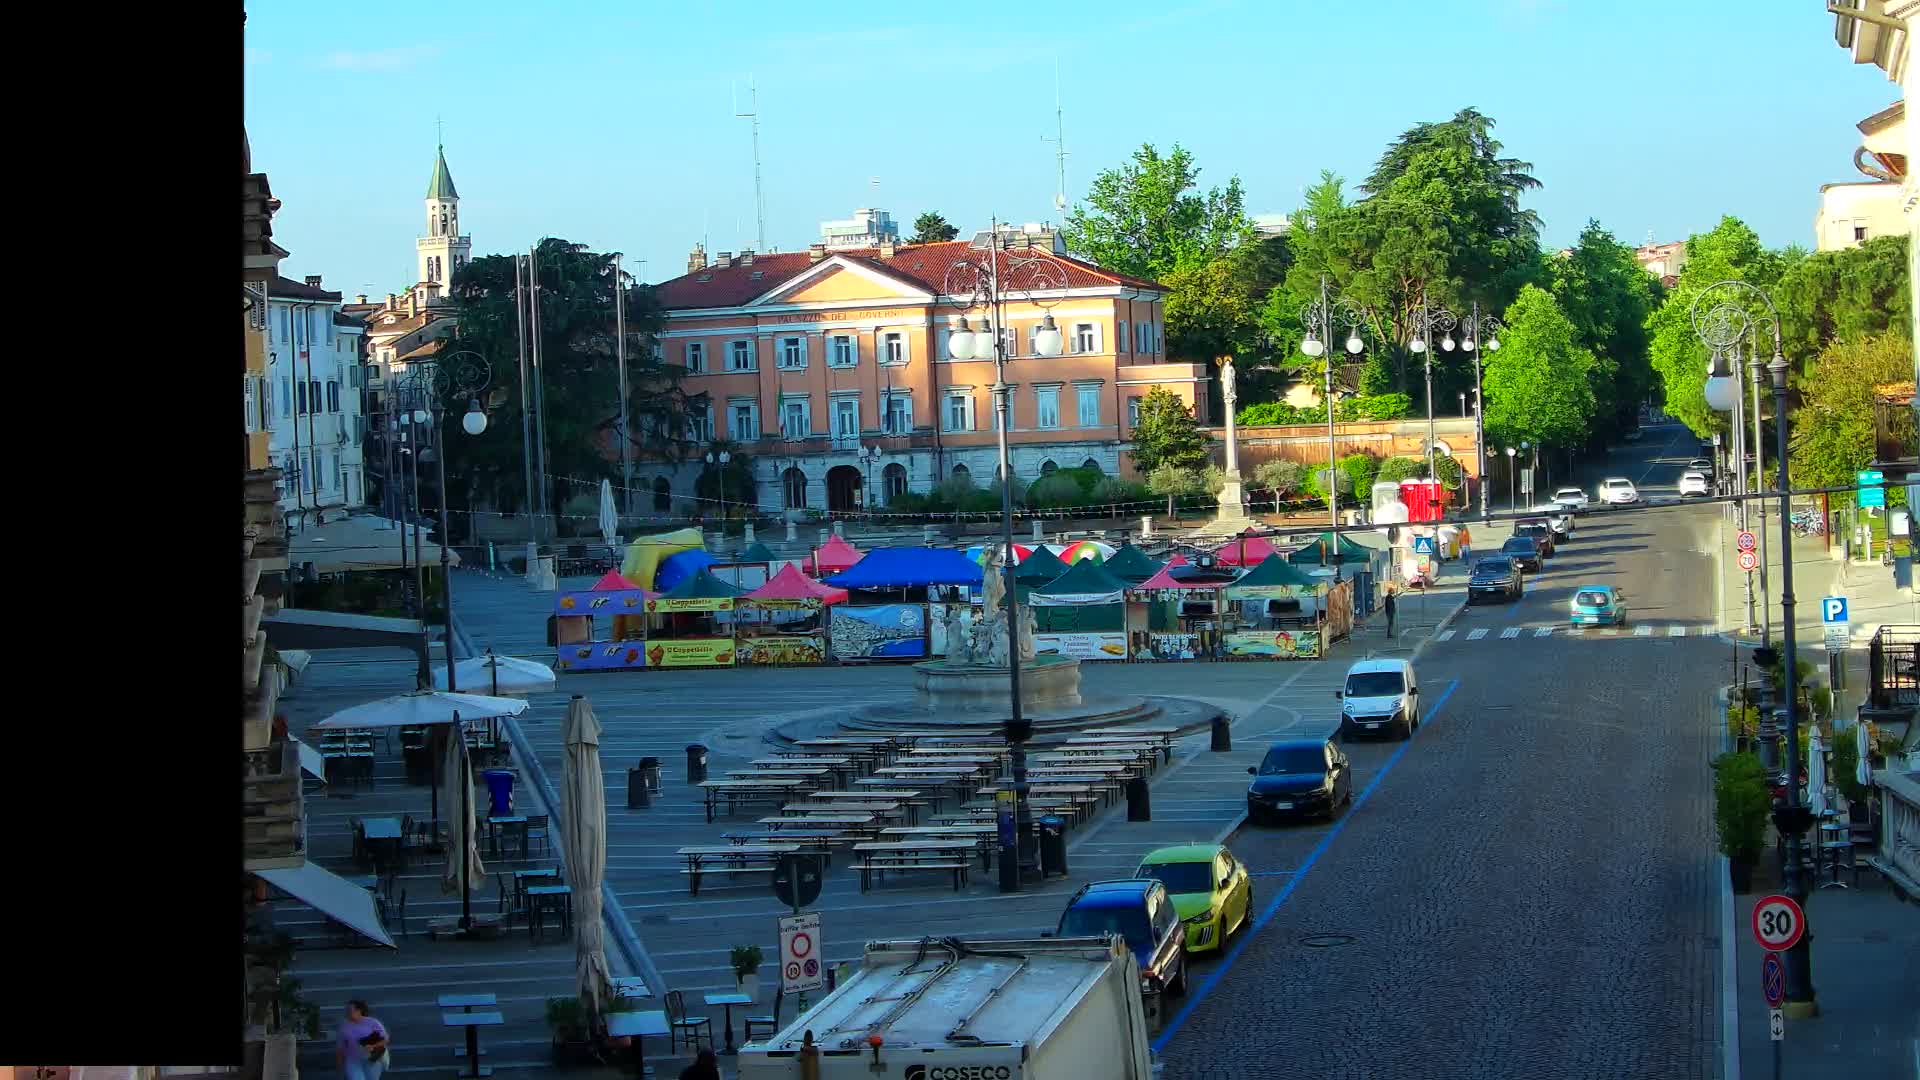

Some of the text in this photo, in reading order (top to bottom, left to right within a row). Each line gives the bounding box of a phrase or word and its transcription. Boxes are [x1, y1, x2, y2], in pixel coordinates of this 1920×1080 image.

[1828, 600, 1843, 621] P
[1762, 910, 1791, 936] 30
[929, 1066, 1010, 1080] COSECO
